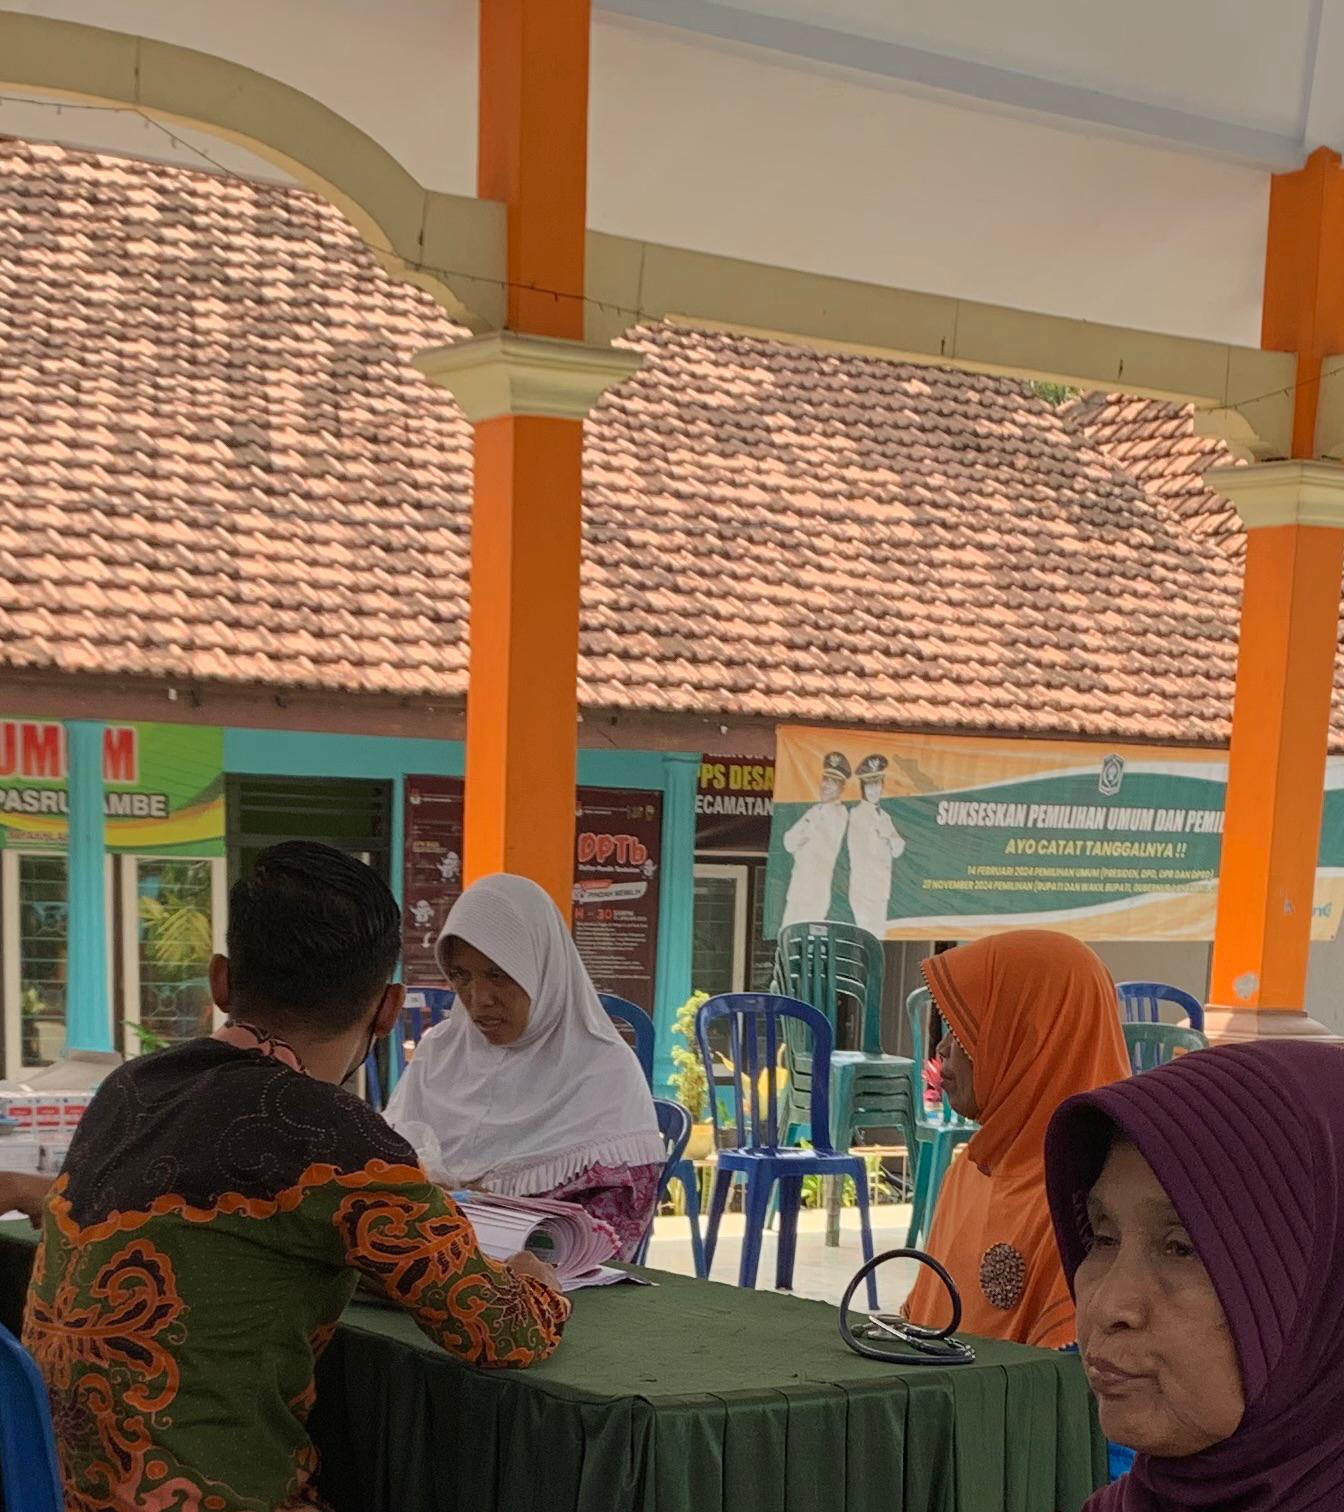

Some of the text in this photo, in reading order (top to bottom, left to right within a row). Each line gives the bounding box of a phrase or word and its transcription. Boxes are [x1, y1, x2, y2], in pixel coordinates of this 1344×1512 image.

[729, 764, 774, 791] DESA
[695, 795, 774, 816] ECAMATAN
[936, 800, 1225, 833] SUKSESKAN PEMILIHAN UMUM DAN PEMIL
[1005, 838, 1036, 855] AYO
[1037, 840, 1084, 857] CATAT
[1084, 841, 1174, 859] TANGGALNYA
